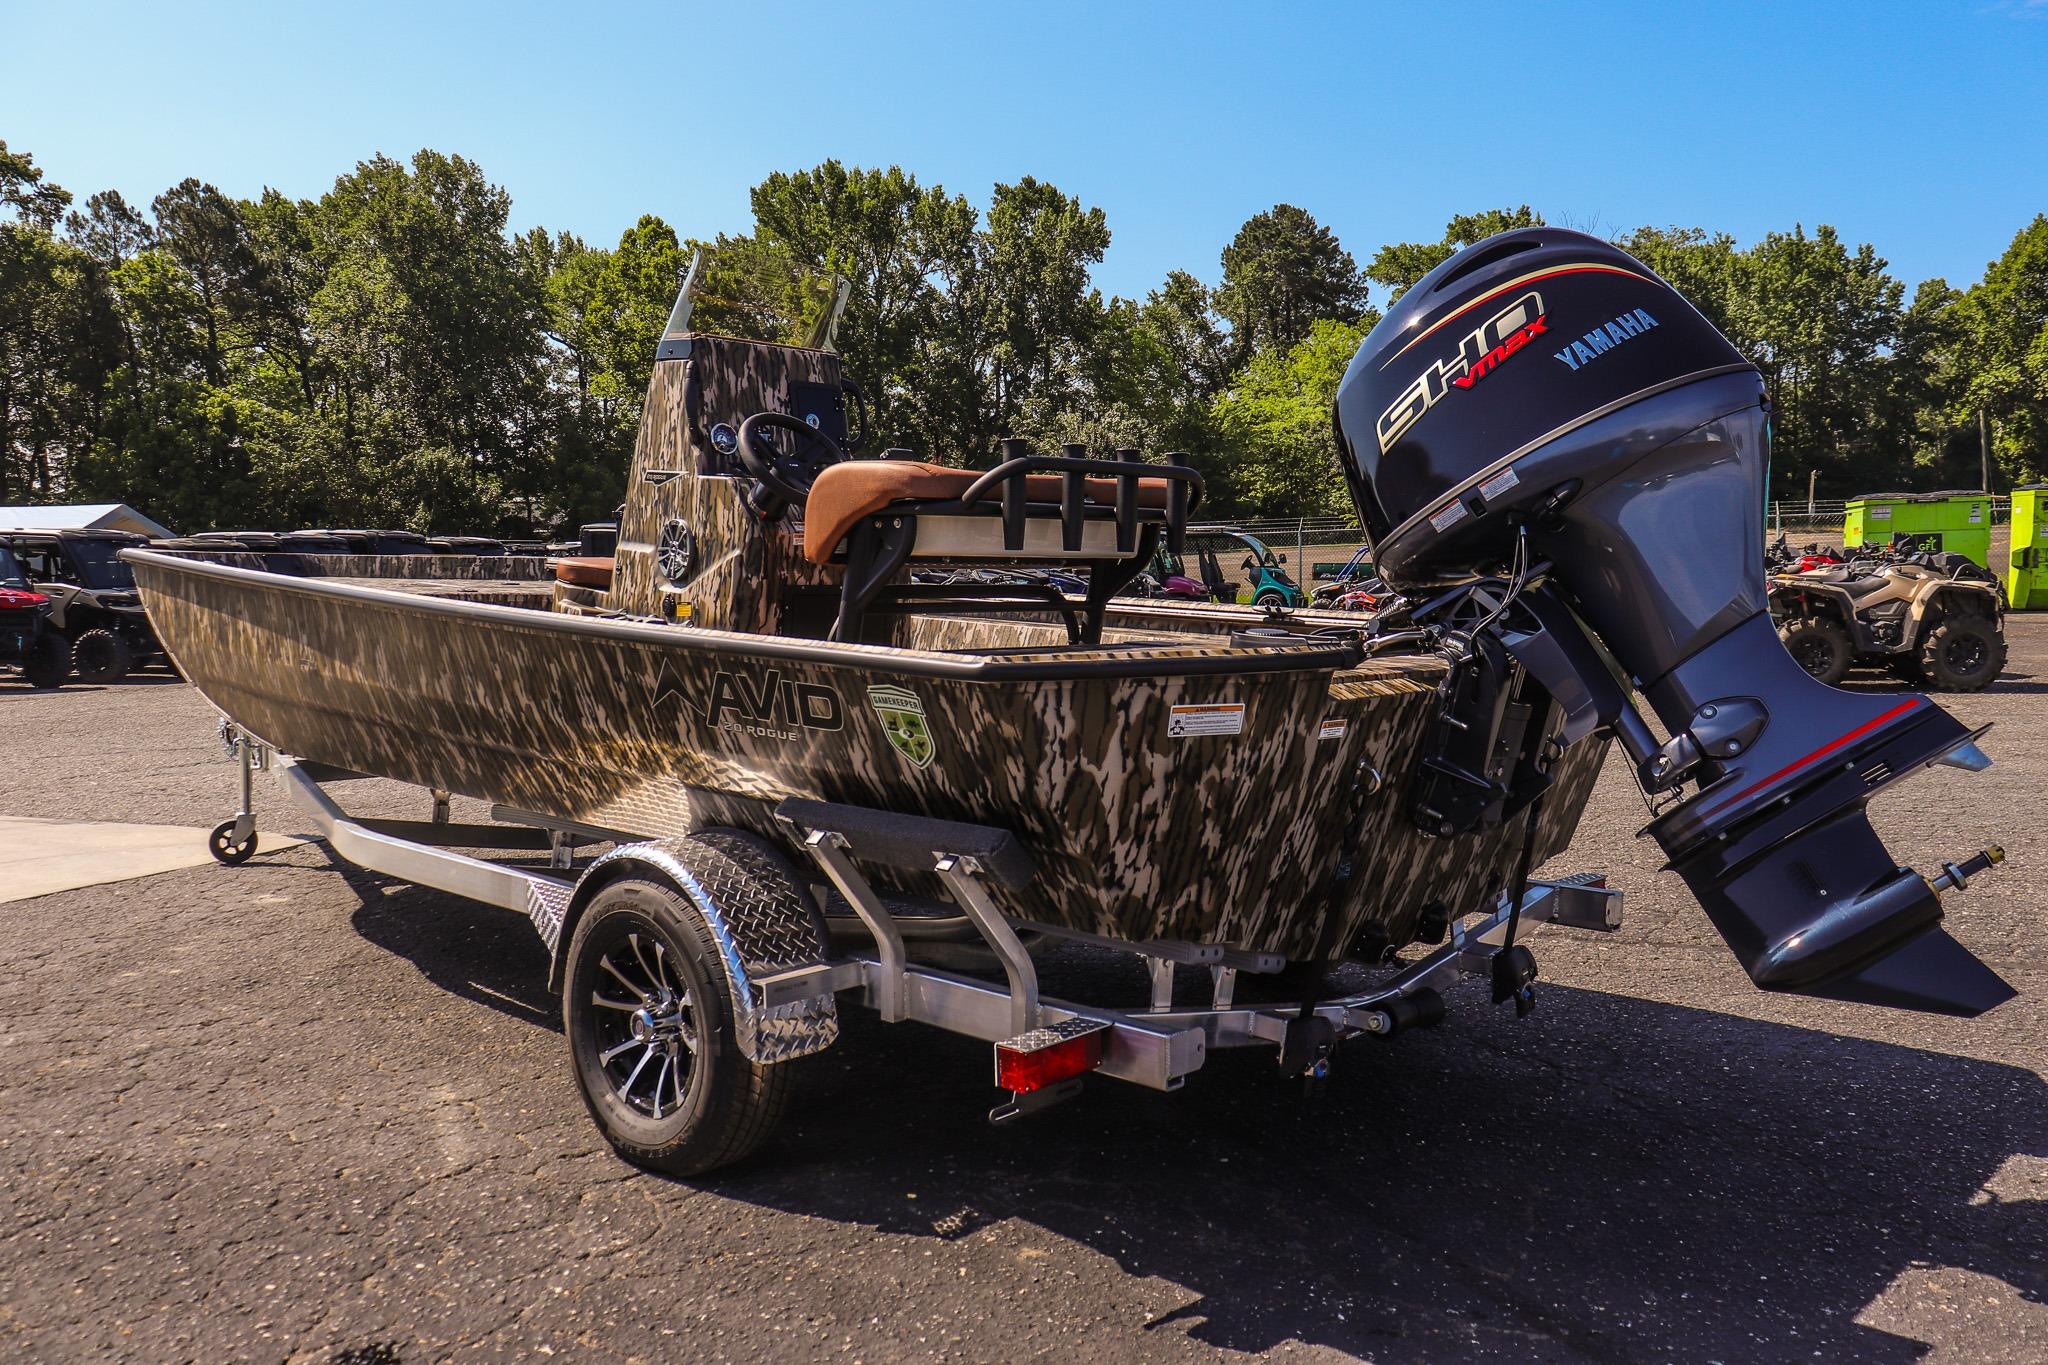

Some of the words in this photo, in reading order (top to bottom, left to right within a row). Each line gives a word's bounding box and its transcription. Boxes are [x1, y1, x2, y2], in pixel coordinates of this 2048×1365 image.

[1553, 307, 1660, 371] YAMAHA
[1376, 291, 1545, 455] SHO
[1918, 542, 1937, 551] GFL
[706, 669, 843, 732] AVID
[872, 693, 920, 711] GAMEKEEPER
[723, 721, 742, 732] 20
[746, 726, 798, 741] ROGUE
